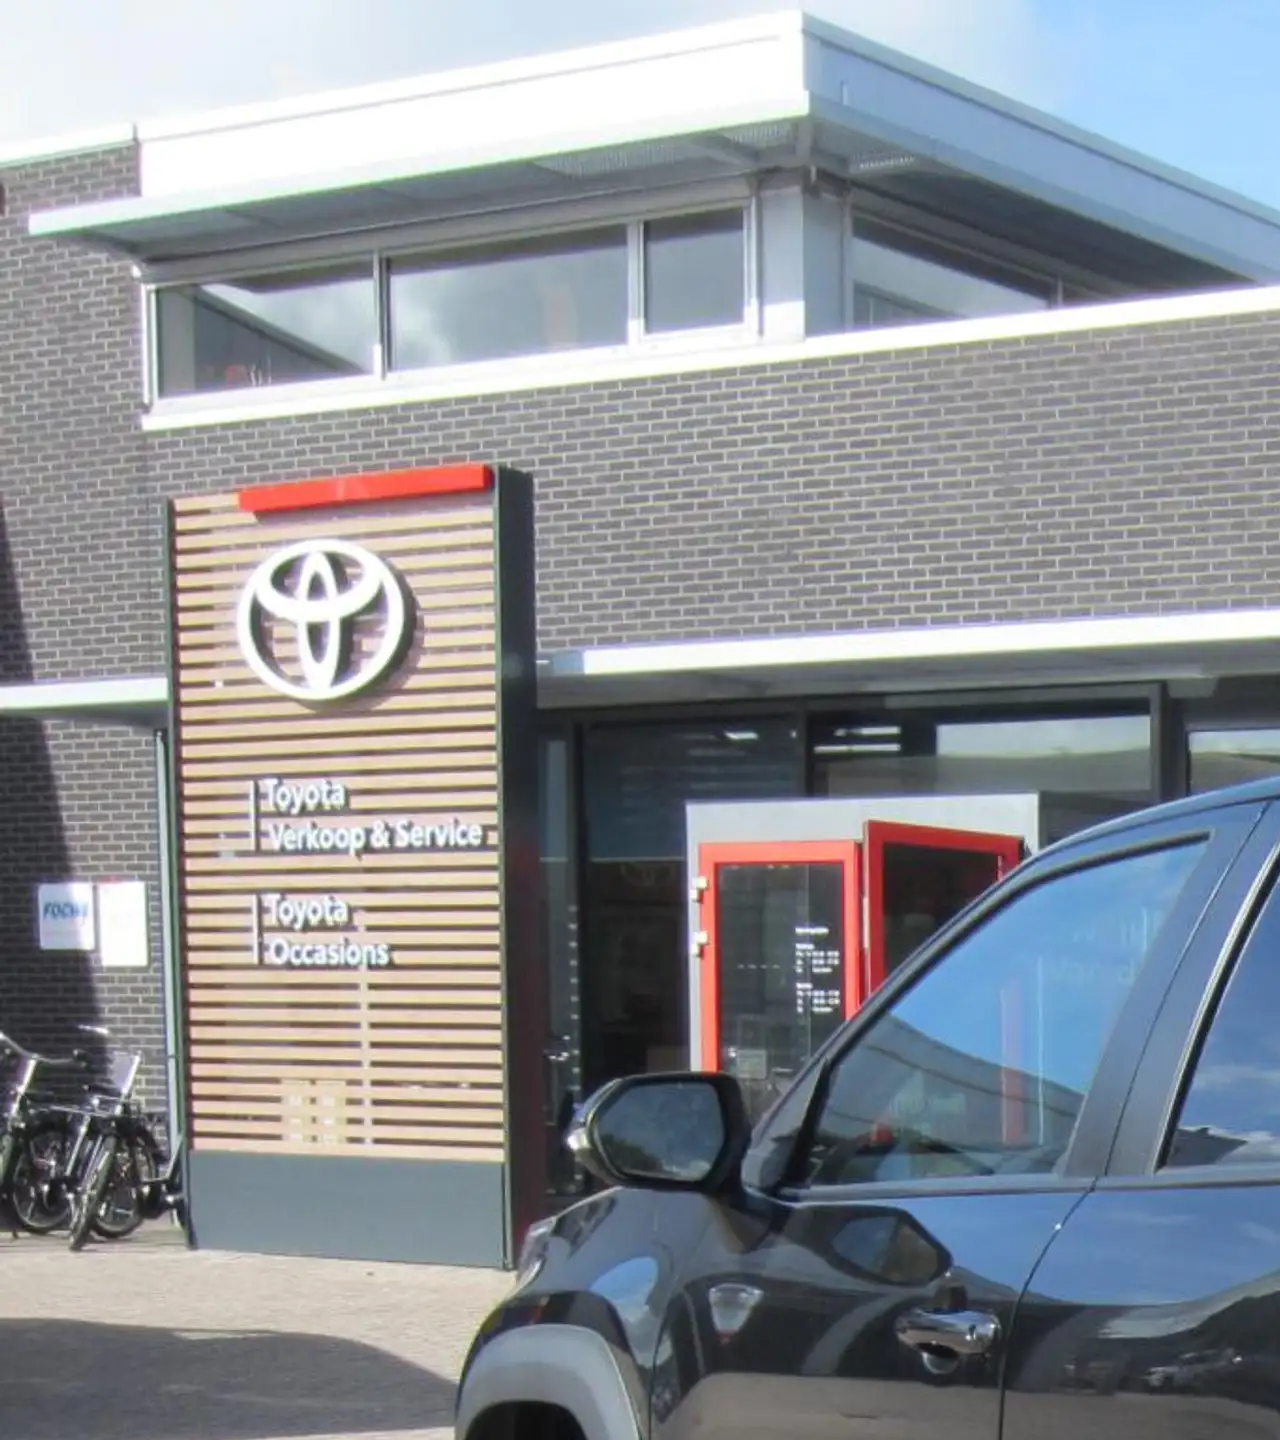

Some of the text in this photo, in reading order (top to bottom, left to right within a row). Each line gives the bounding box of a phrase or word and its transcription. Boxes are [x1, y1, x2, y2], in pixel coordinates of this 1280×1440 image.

[262, 777, 346, 814] Toyota
[269, 818, 483, 856] Verkoop & Service
[263, 893, 348, 930] Toyota
[268, 937, 391, 966] Occasions
